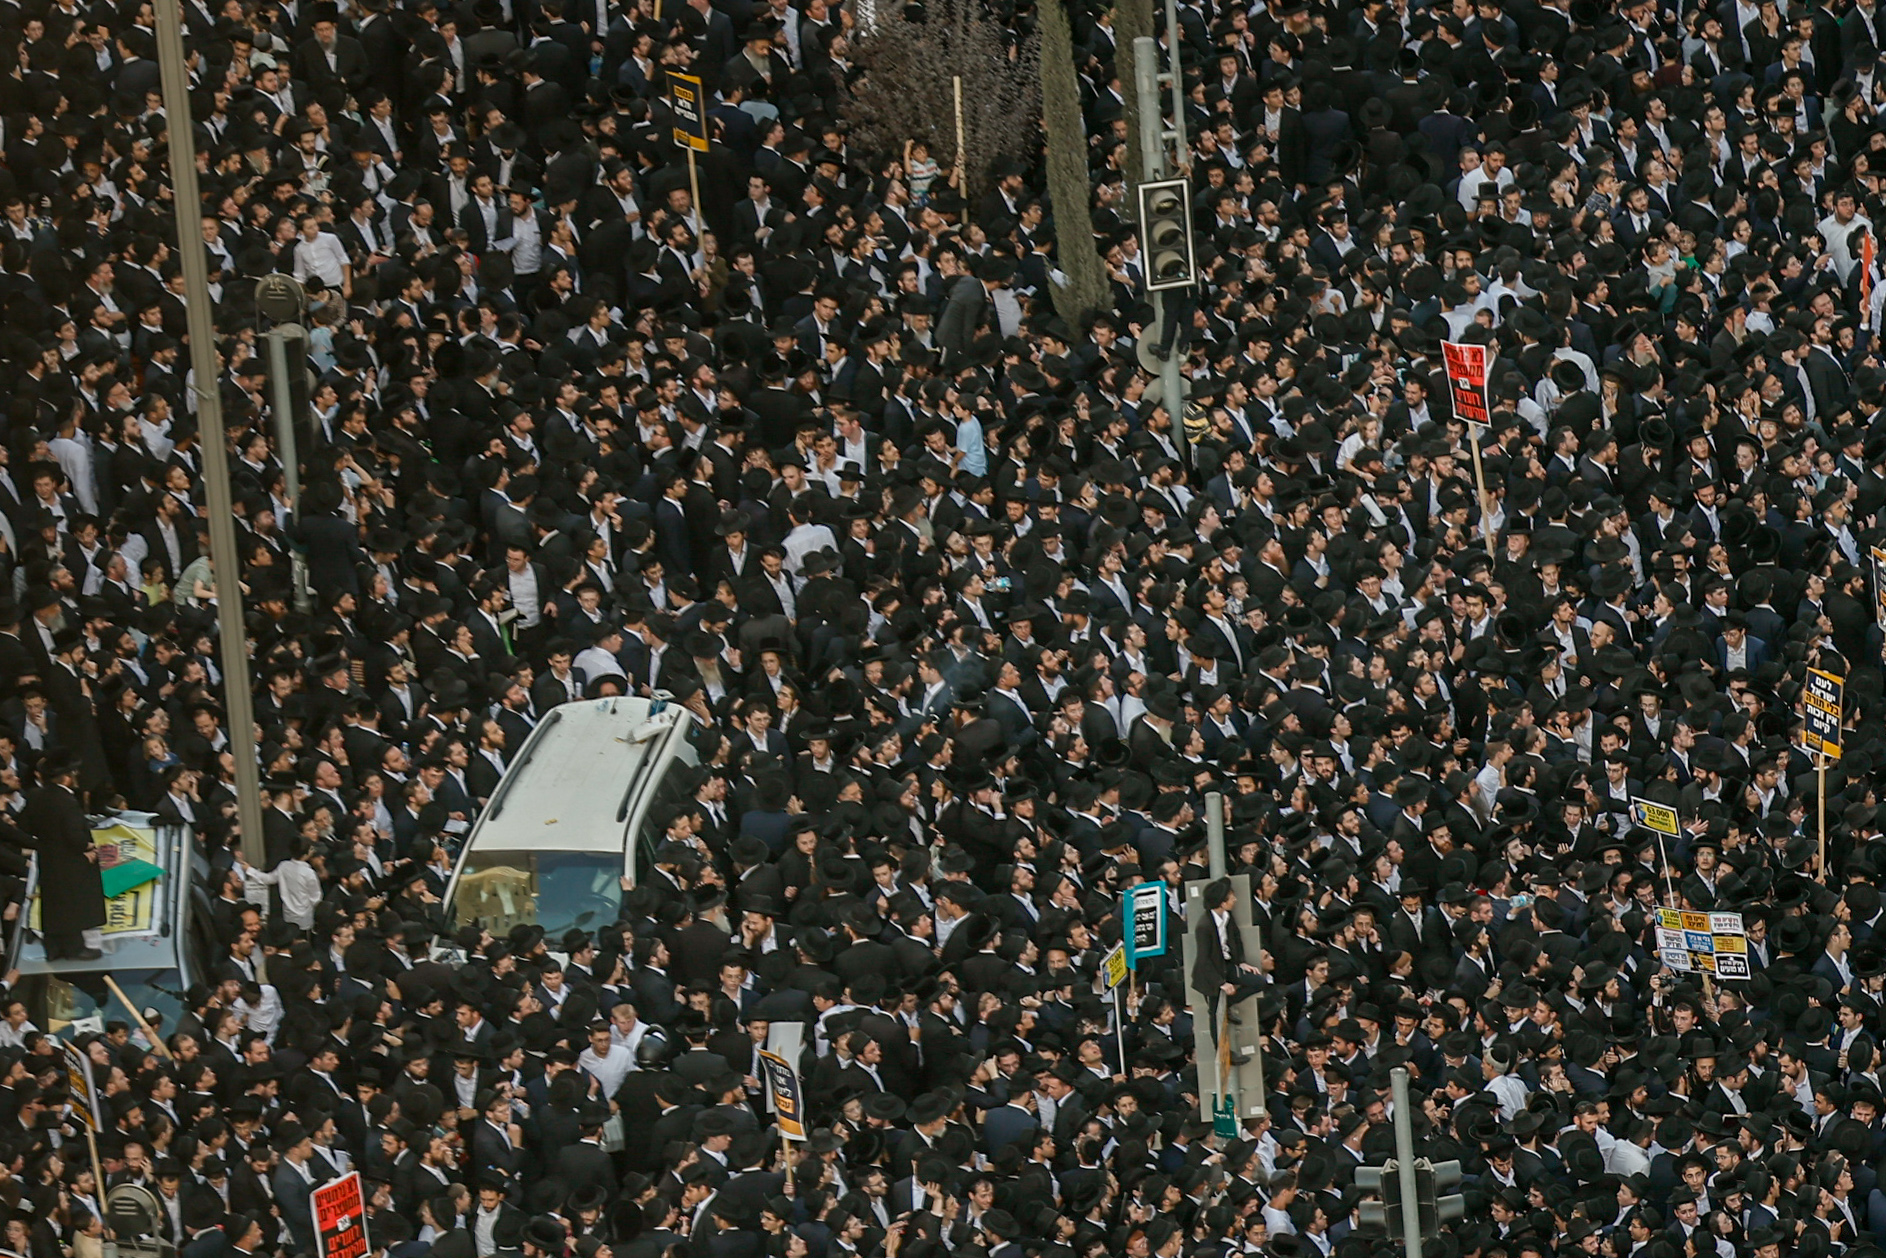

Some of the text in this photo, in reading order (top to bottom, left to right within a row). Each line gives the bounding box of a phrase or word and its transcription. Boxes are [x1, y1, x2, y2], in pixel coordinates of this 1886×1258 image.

[1810, 683, 1836, 703] ישראל
[1815, 675, 1832, 691] לעם
[1806, 693, 1839, 715] בלי תורה
[1806, 704, 1838, 726] אין זכות
[1813, 718, 1831, 734] קיום
[315, 1178, 358, 1207] לא נרתעים
[328, 1225, 361, 1251] רועדים
